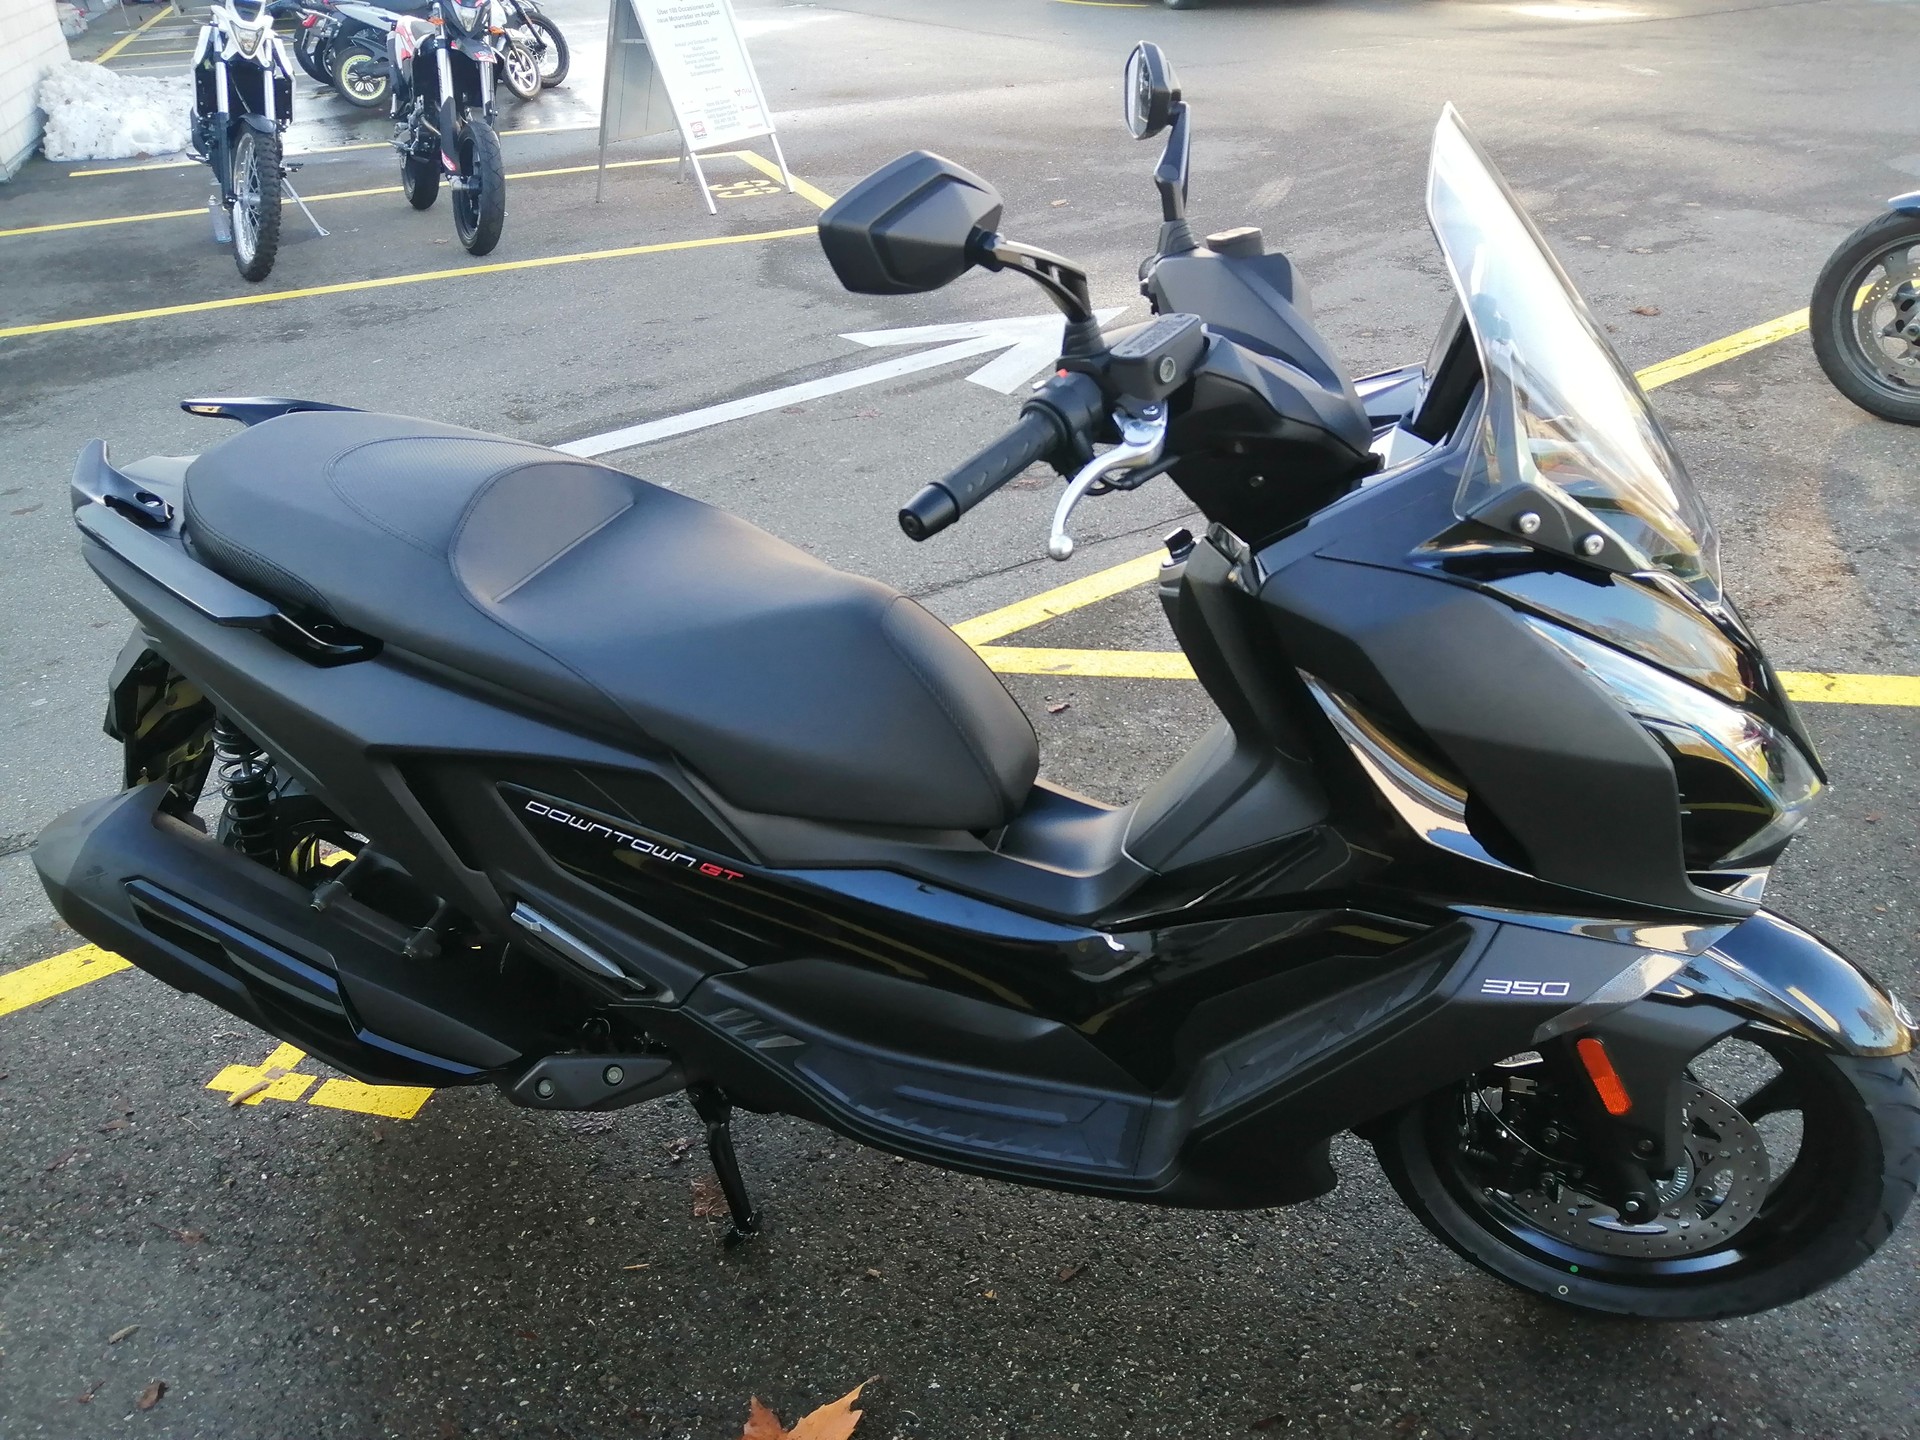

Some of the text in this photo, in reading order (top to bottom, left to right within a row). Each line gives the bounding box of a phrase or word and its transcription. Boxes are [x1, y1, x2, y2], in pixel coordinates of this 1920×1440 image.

[701, 9, 721, 18] Angebot
[525, 800, 744, 881] DOWNTOWN GT
[1480, 978, 1570, 996] 350
